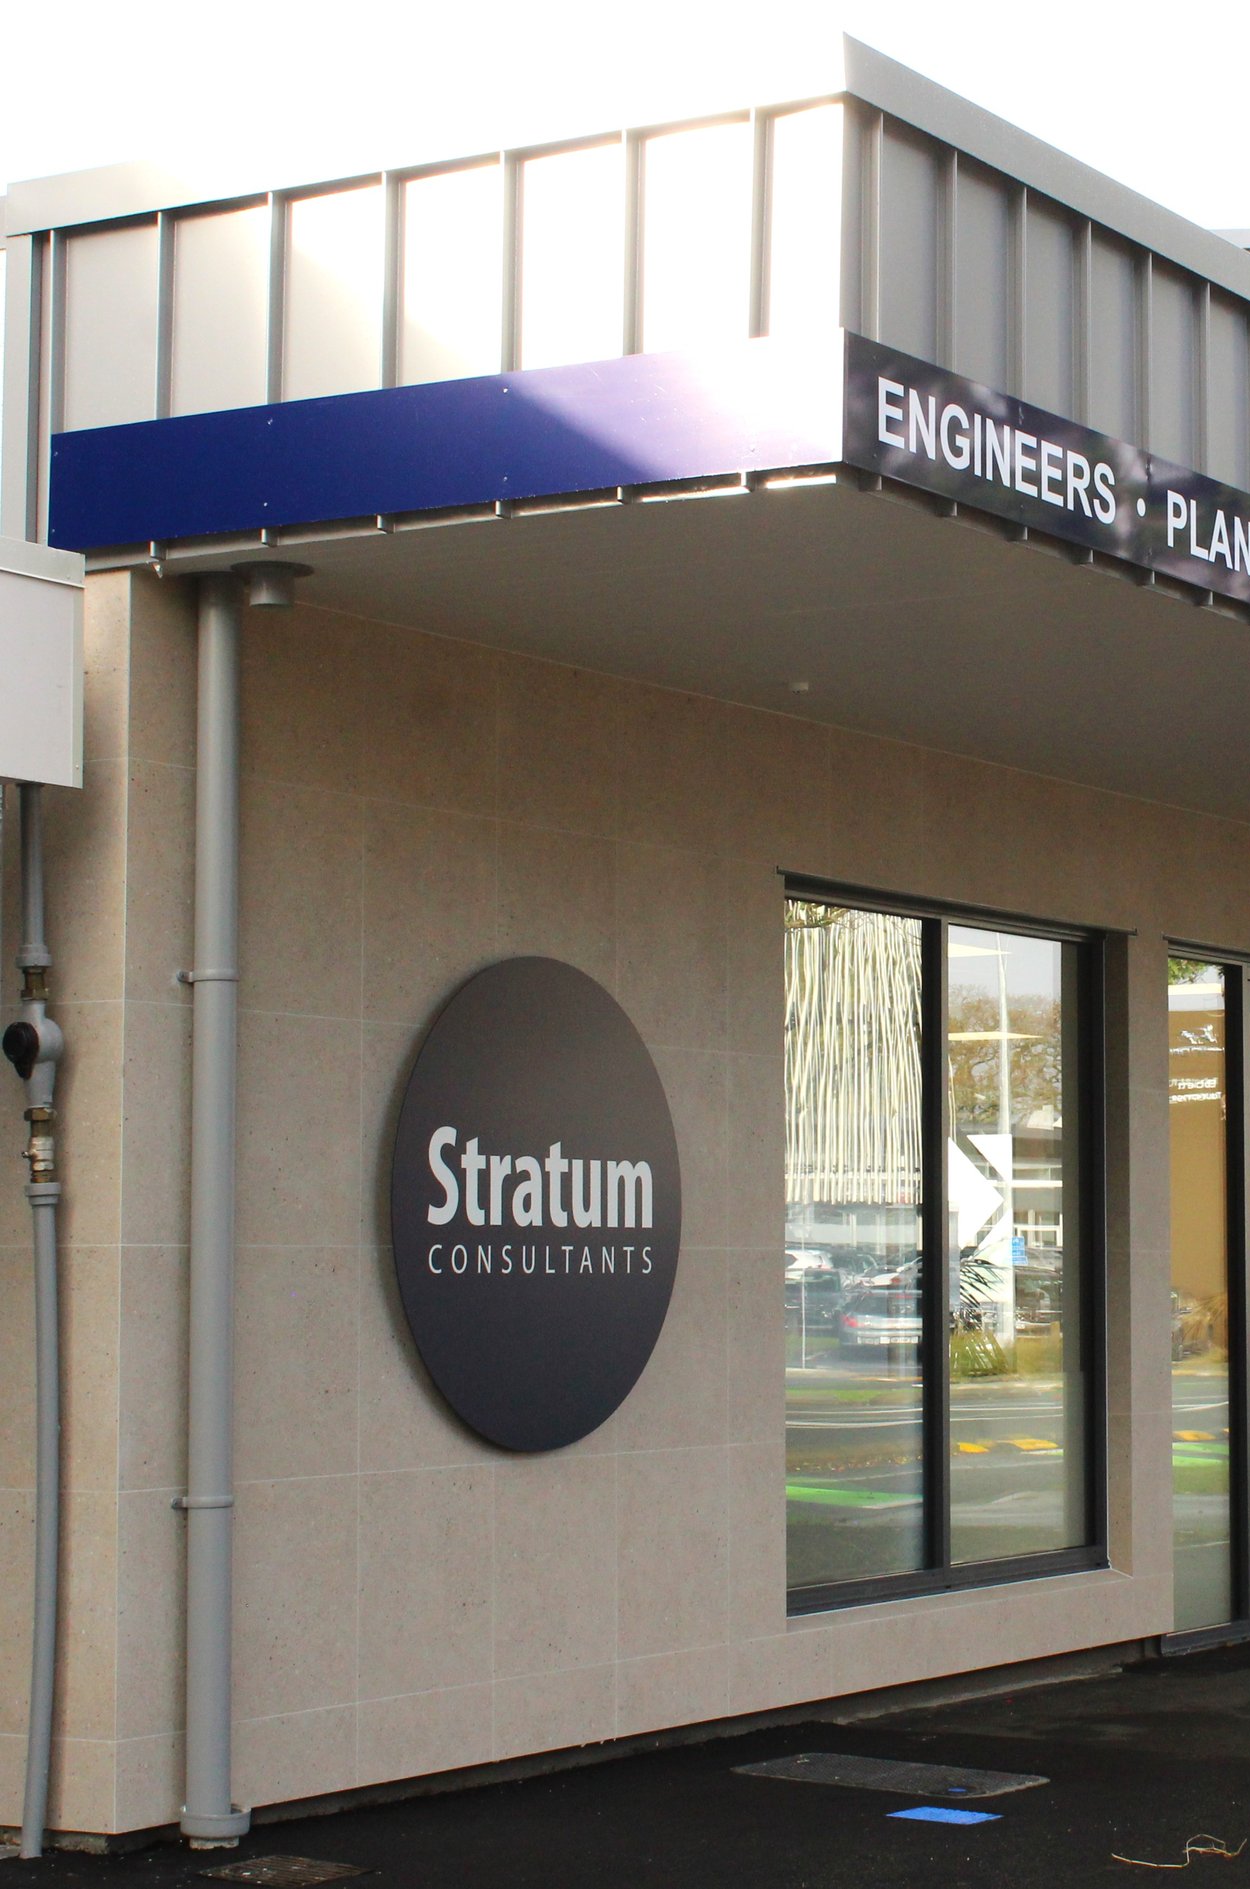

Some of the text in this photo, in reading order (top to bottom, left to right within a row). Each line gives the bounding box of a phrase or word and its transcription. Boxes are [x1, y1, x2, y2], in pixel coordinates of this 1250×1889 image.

[878, 376, 1117, 525] ENGINEERS
[427, 1126, 653, 1228] Stratum
[428, 1244, 653, 1274] CONSULTANTS
